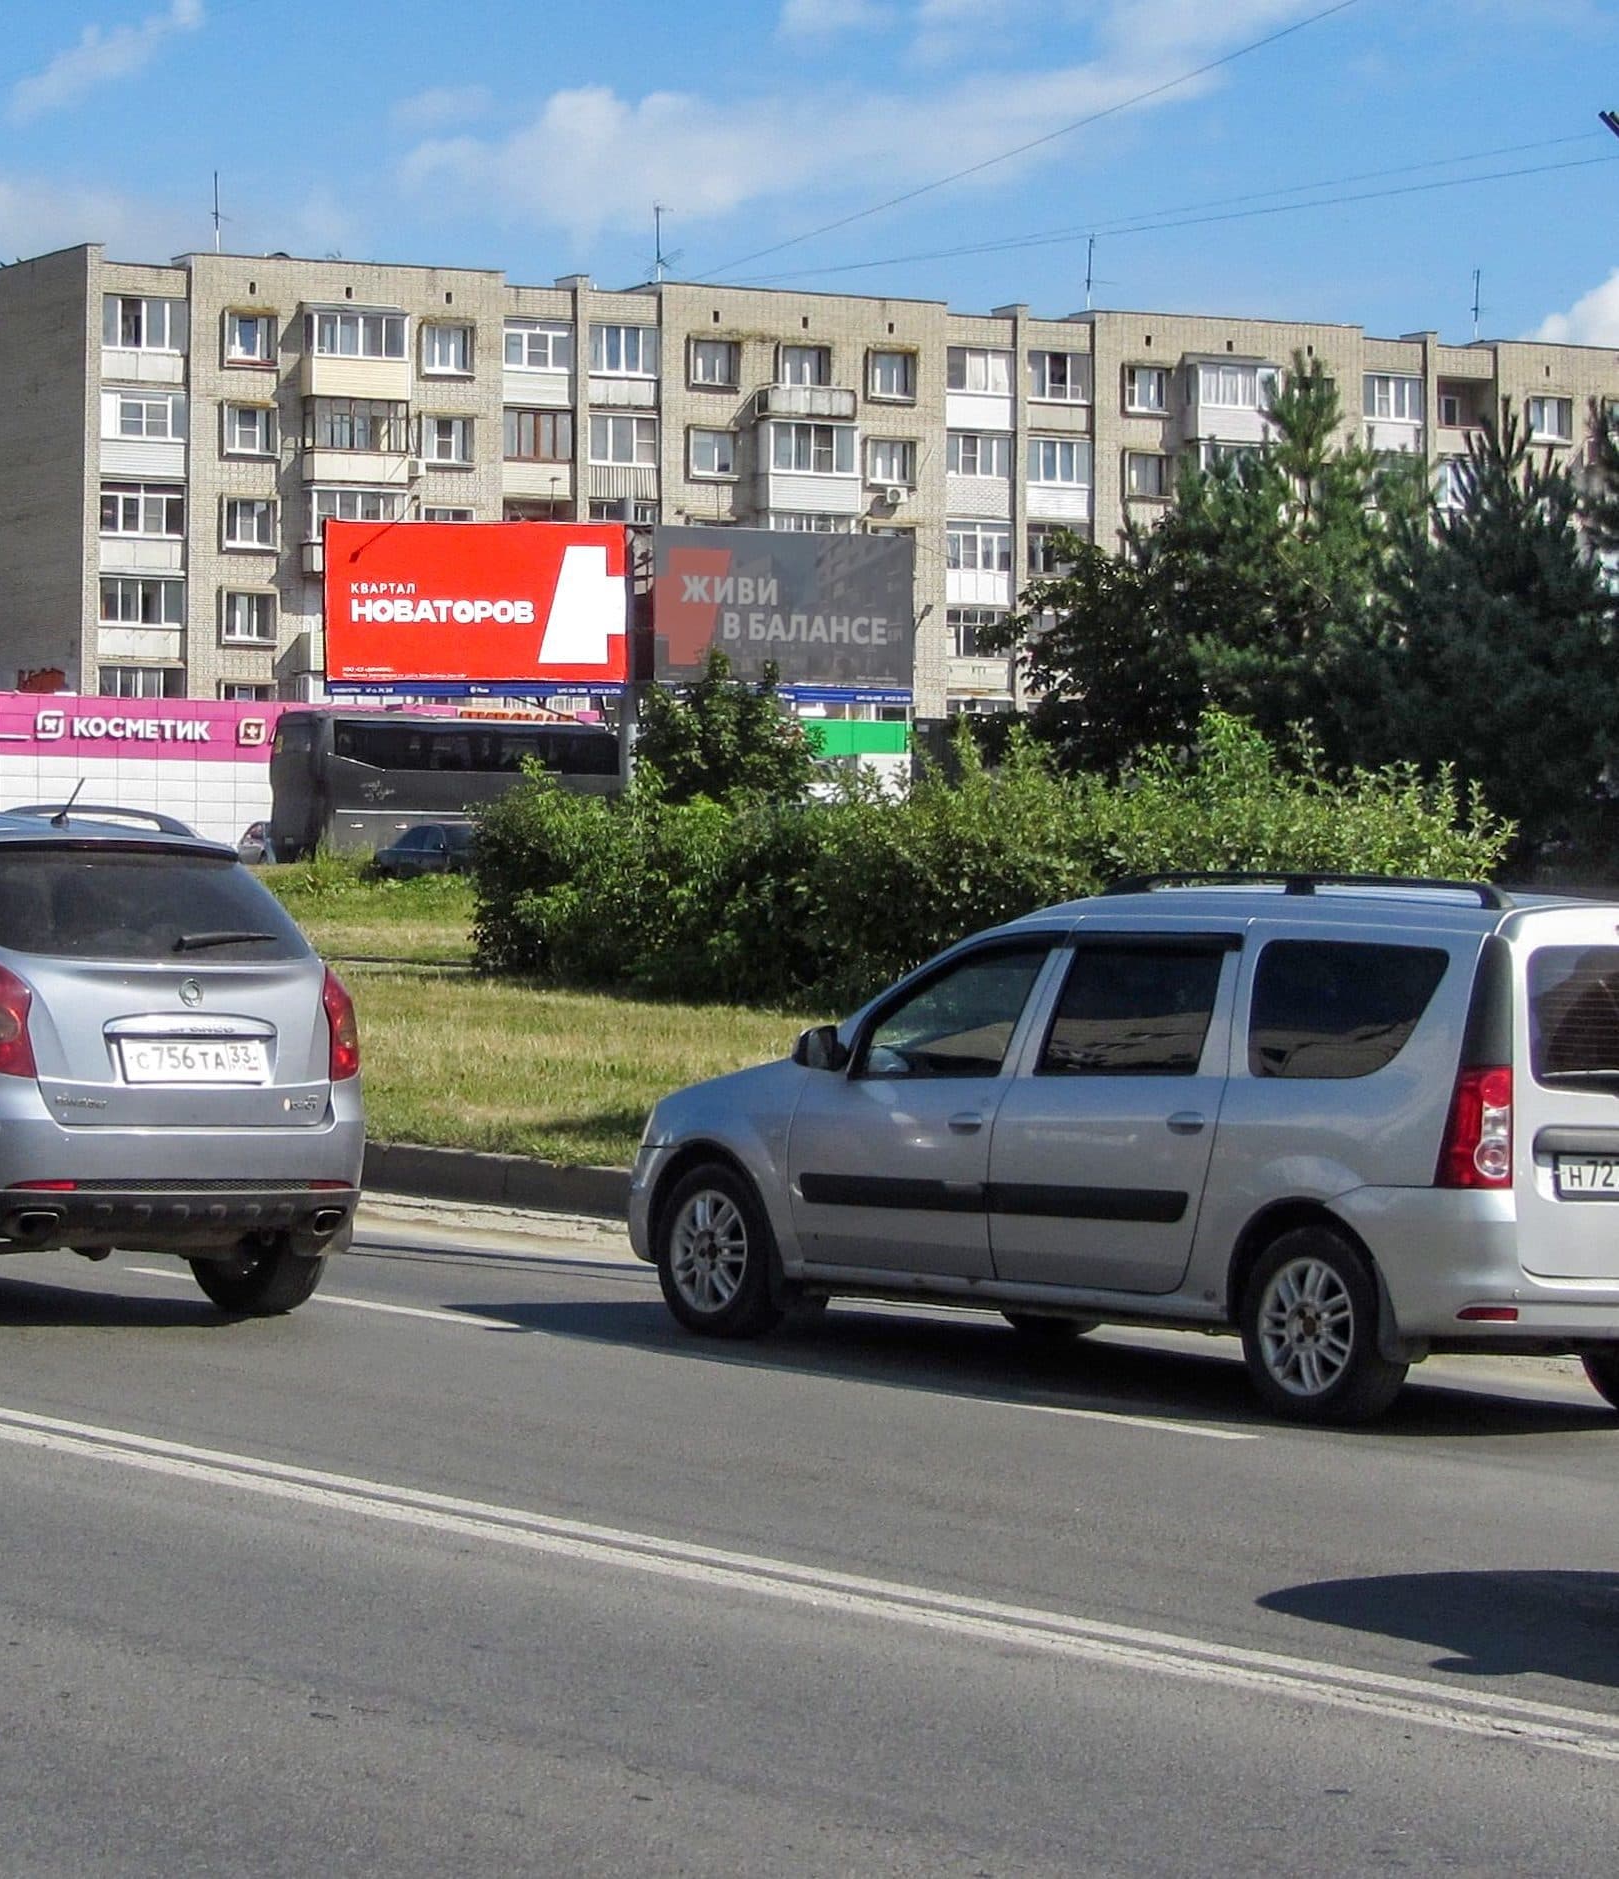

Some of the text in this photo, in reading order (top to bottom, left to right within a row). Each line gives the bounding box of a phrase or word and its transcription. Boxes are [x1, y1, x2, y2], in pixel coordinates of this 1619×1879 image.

[350, 582, 416, 595] КВАРТАЛ
[681, 575, 779, 606] ЖИВИ
[351, 599, 535, 624] НОВАТОРОВ
[723, 612, 888, 645] В БАЛАНСЕ
[73, 716, 211, 741] КОСМЕТИК
[1569, 1160, 1619, 1187] Н72
